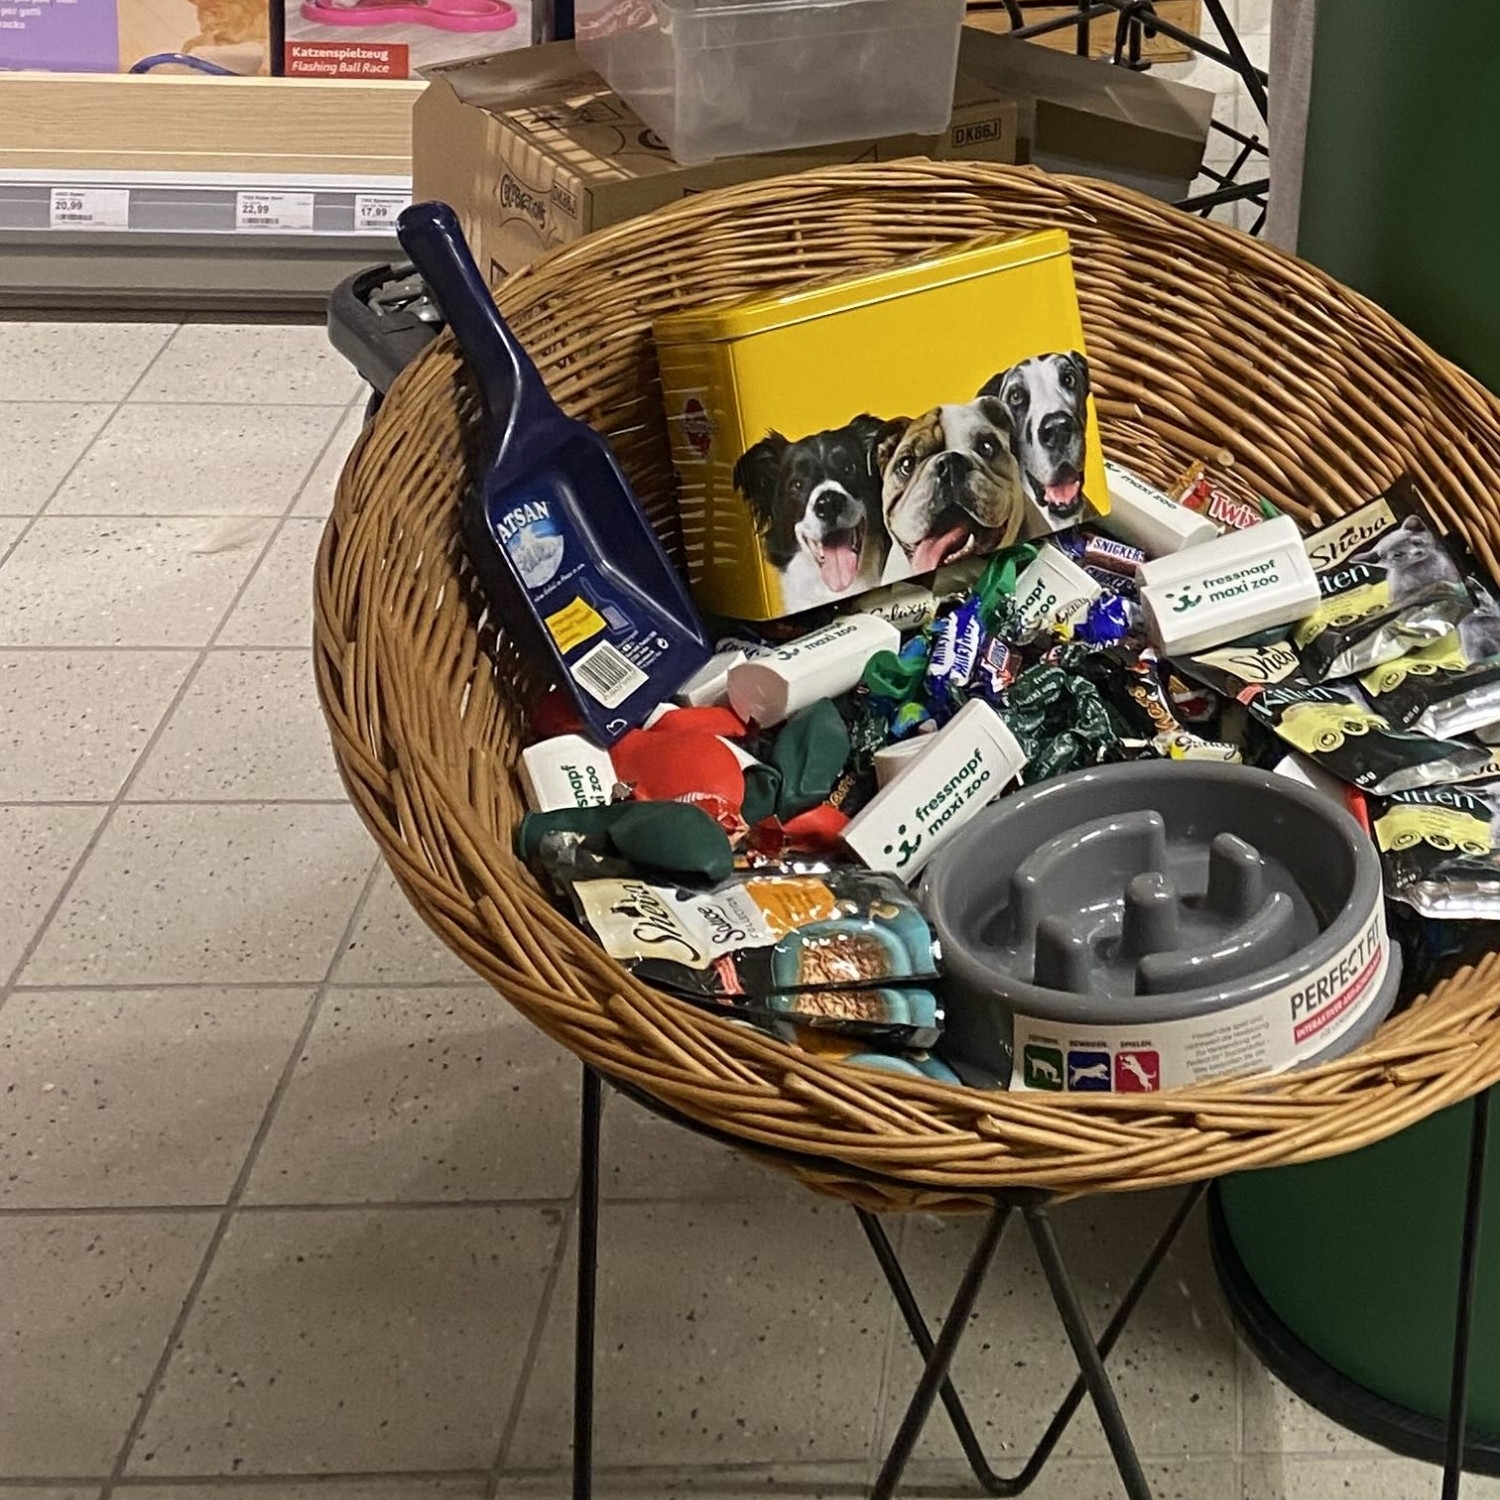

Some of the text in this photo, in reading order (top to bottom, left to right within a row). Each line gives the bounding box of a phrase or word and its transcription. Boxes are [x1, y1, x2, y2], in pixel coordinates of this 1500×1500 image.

[292, 46, 390, 62] Katzenspielzeug
[292, 61, 390, 76] Flashing Ball Race
[55, 200, 83, 211] 20,99
[242, 204, 269, 215] 22,99
[360, 207, 388, 217] 17,99
[495, 501, 551, 545] ATSAN
[1210, 489, 1262, 529] Twix
[1093, 537, 1146, 562] SNICKERS
[1308, 515, 1388, 570] Sheba
[1202, 559, 1277, 589] fressnapf
[1209, 573, 1279, 602] maxi zoo
[803, 632, 834, 652] maxi
[835, 624, 858, 640] zoo
[1251, 684, 1333, 717] Kitten
[915, 748, 983, 822] fressnapf
[928, 770, 990, 836] maxi zoo
[698, 904, 746, 944] Sauce
[1290, 940, 1365, 1021] PERFECT
[1367, 913, 1380, 956] FIT
